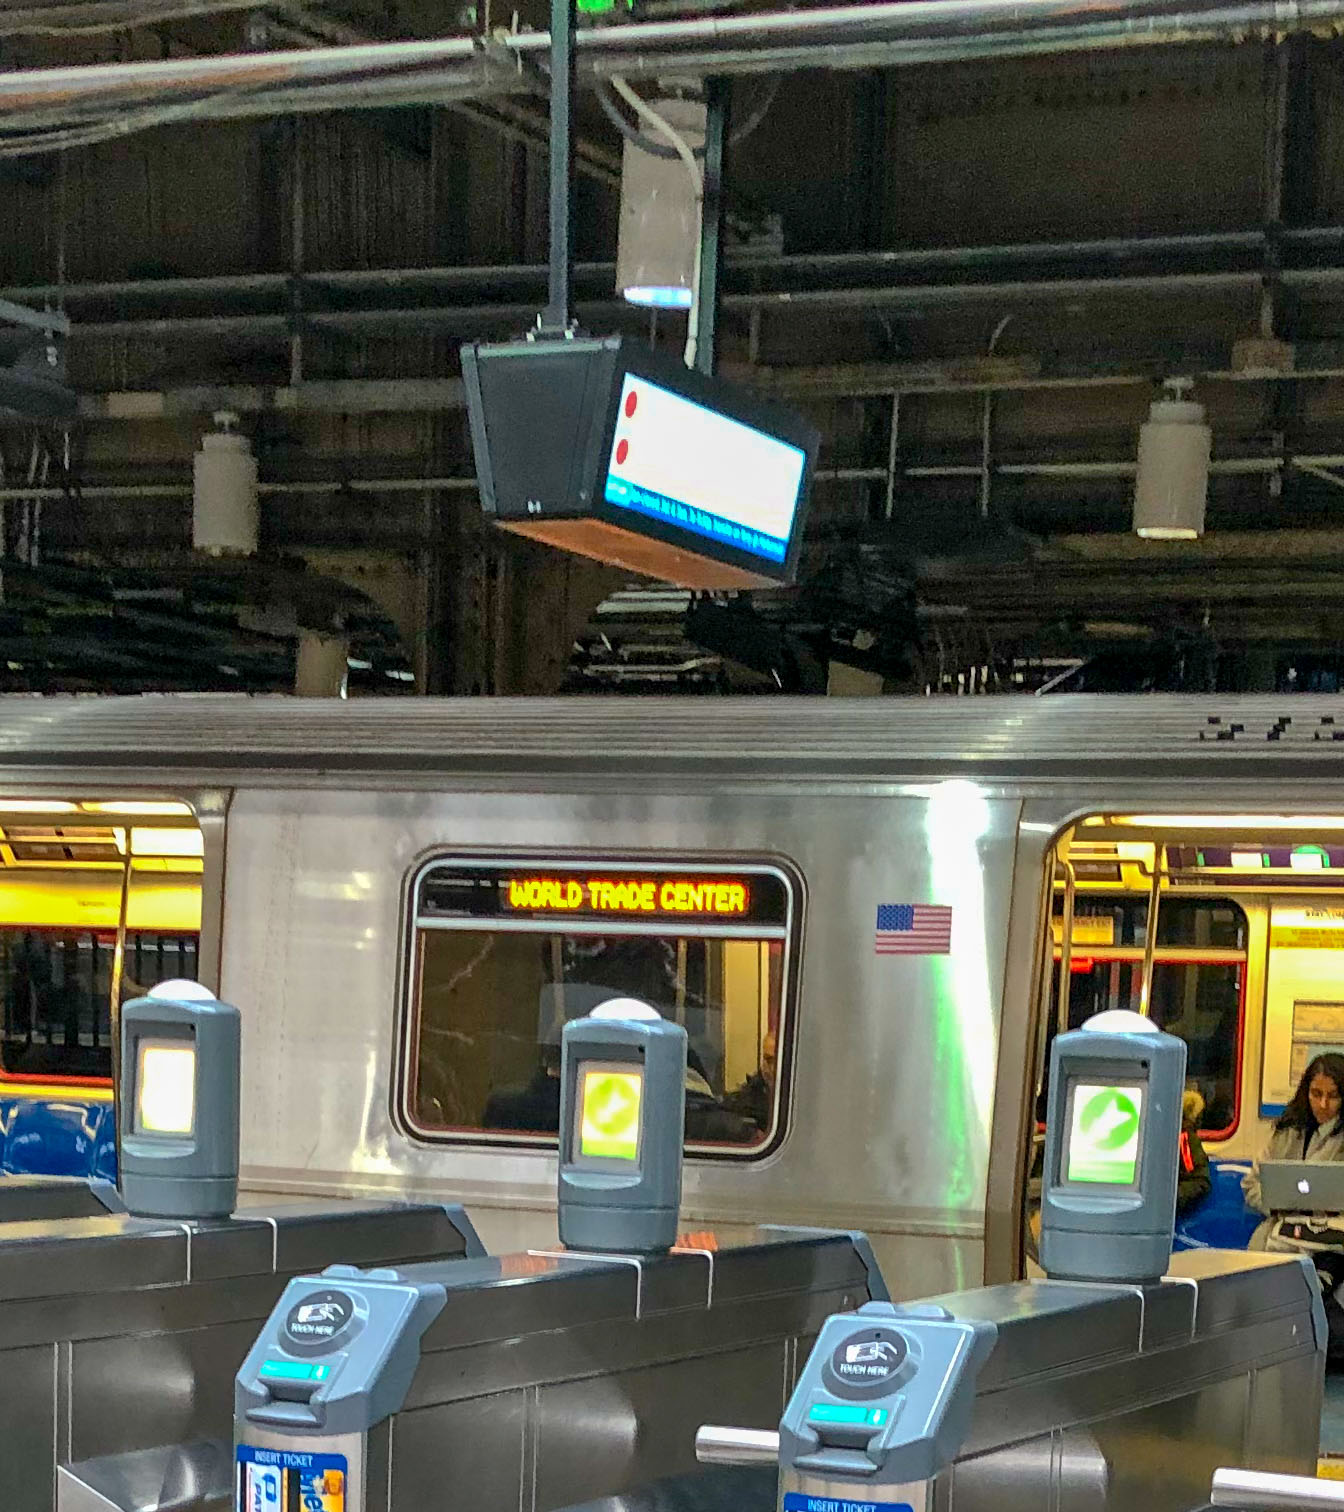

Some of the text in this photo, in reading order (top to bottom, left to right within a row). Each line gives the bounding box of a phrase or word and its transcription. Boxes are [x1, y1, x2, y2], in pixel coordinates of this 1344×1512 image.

[510, 880, 745, 912] WORLD TRADE CENTER
[254, 1450, 314, 1467] INSERT TICKET
